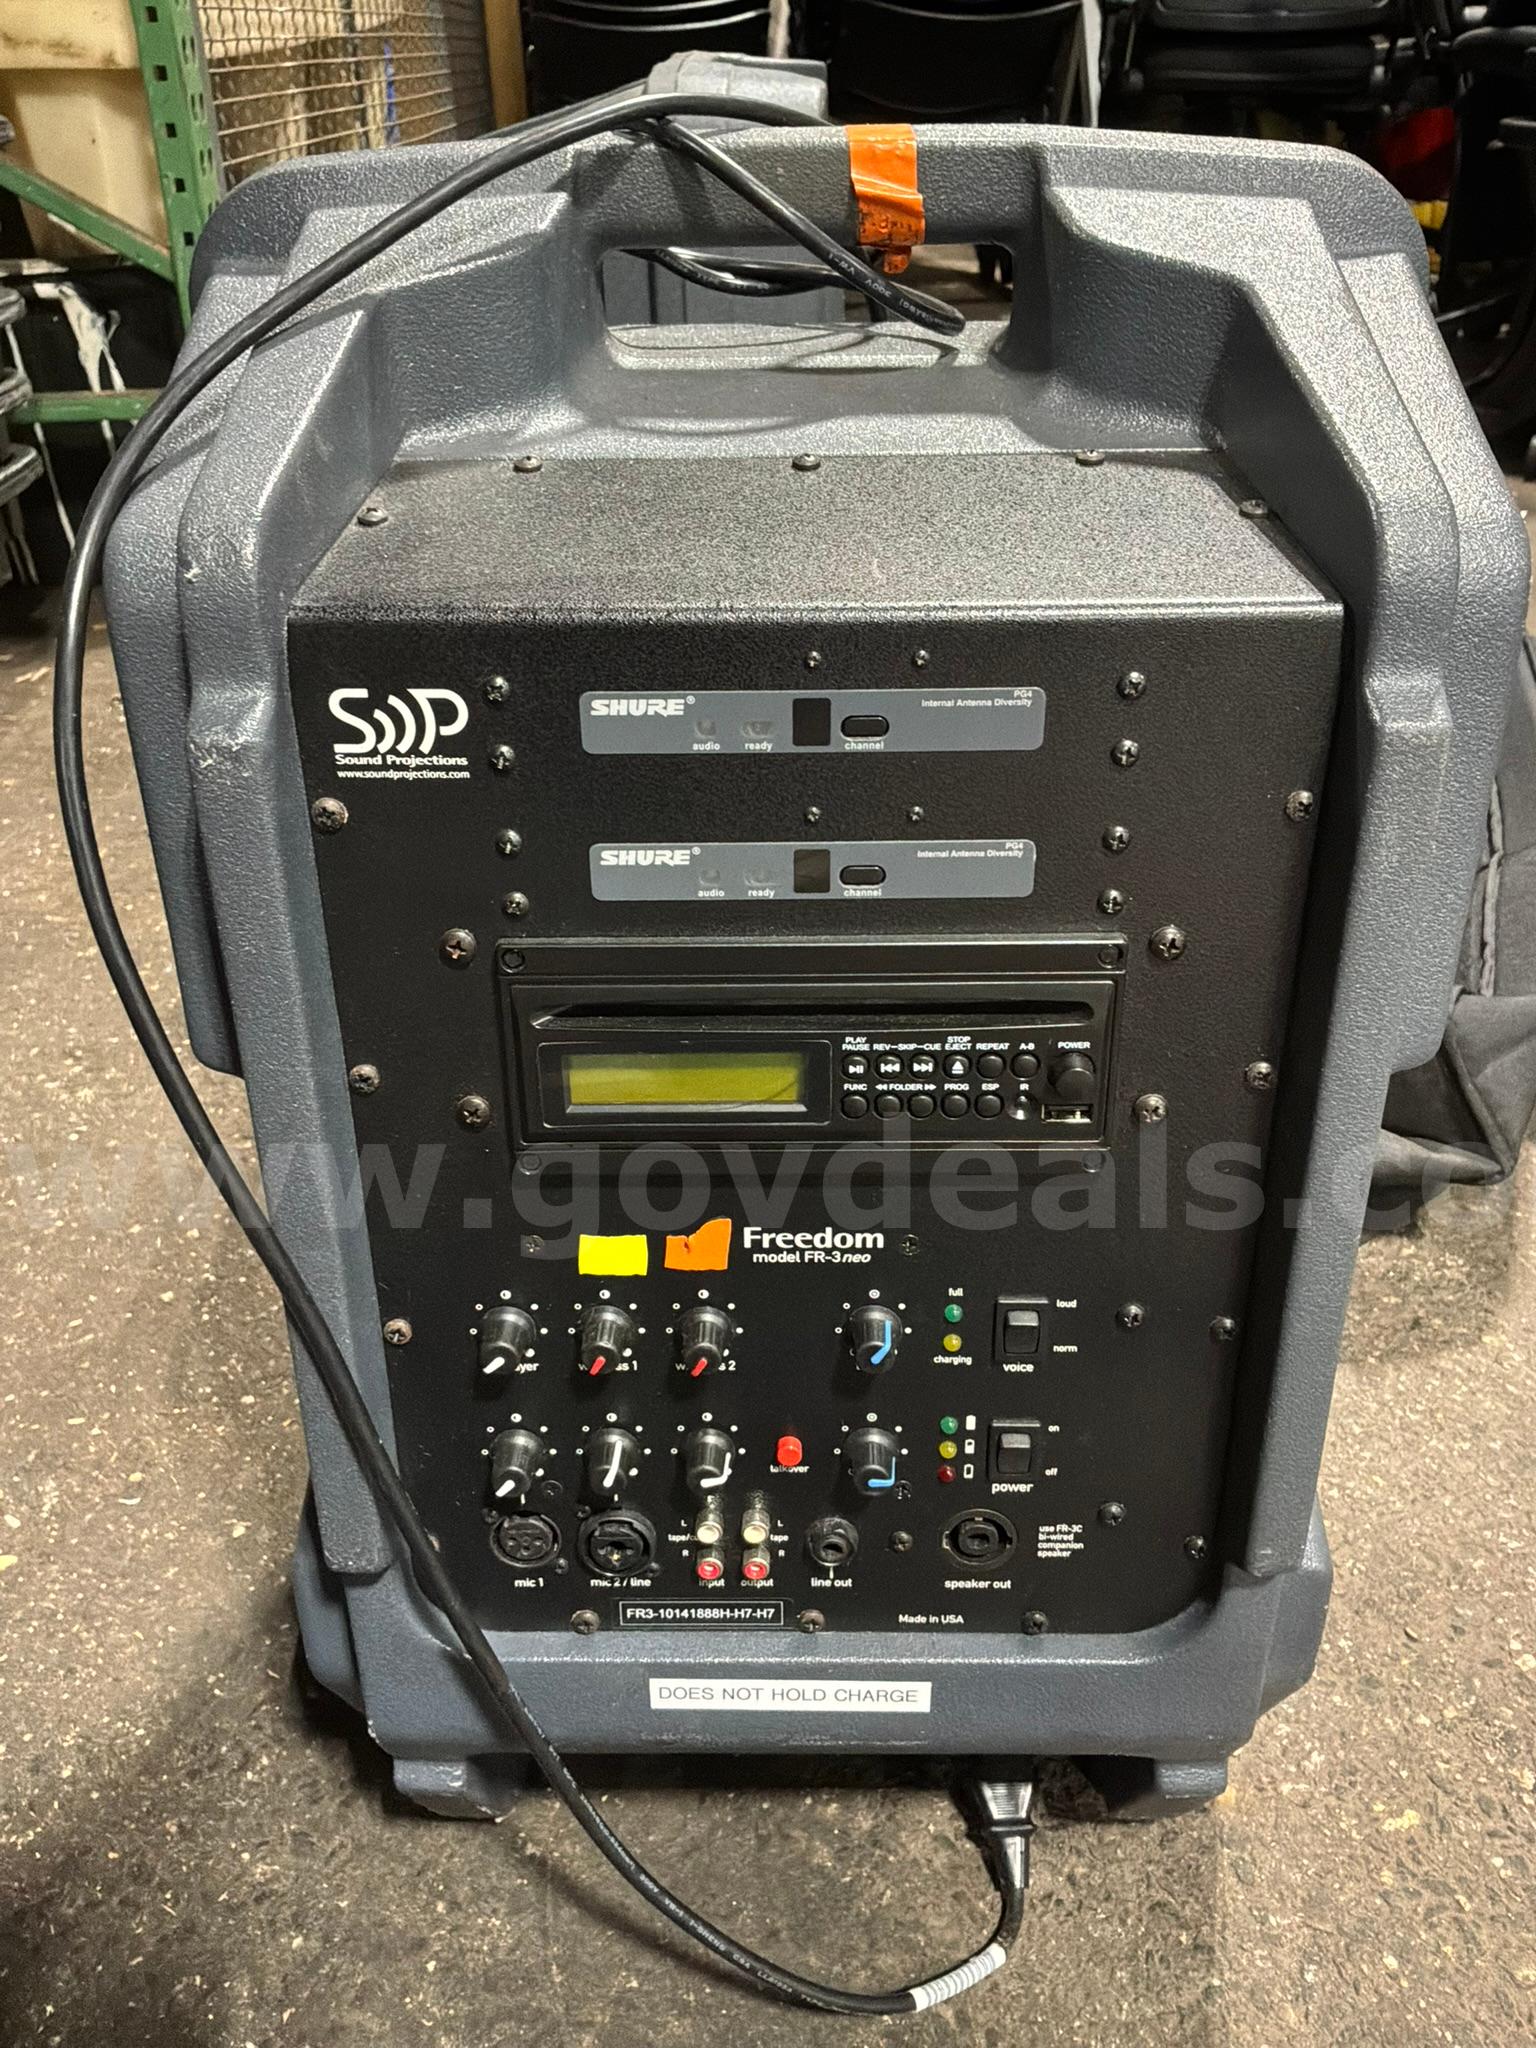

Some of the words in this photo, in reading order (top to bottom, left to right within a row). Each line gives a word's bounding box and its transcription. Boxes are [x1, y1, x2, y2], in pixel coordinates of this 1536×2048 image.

[1014, 690, 1032, 698] PG4
[921, 699, 955, 707] Internal
[957, 699, 992, 707] Antenna
[994, 699, 1032, 707] Diversity
[692, 742, 720, 751] audio
[744, 742, 773, 752] ready
[844, 741, 884, 750] channel
[335, 754, 382, 766] Sound
[387, 754, 468, 768] Projections
[337, 769, 470, 780] www.soundprojections.com
[1005, 842, 1023, 850] PG4
[917, 850, 948, 858] Internal
[951, 850, 985, 858] Antenna
[987, 850, 1023, 858] Diversity
[698, 889, 725, 897] audio
[748, 889, 775, 899] ready
[843, 888, 882, 897] channel
[743, 1227, 884, 1248] Freedom
[752, 1252, 801, 1263] model
[948, 1288, 963, 1296] full
[1056, 1299, 1076, 1308] loud
[1053, 1345, 1077, 1353] norm
[933, 1354, 972, 1365] charging
[728, 1360, 736, 1371] 2
[1003, 1362, 1034, 1372] voice
[1045, 1468, 1058, 1476] off
[991, 1483, 1033, 1495] power
[1056, 1524, 1083, 1532] FR-3C
[770, 1534, 789, 1543] tape
[1038, 1533, 1074, 1541] bi-wired
[1038, 1542, 1084, 1550] companion
[682, 1549, 689, 1557] R
[778, 1549, 785, 1557] R
[1037, 1550, 1072, 1558] speaker
[514, 1578, 536, 1587] mic
[590, 1578, 611, 1586] mic
[613, 1578, 621, 1587] 2
[630, 1578, 651, 1587] line
[699, 1578, 725, 1588] input
[740, 1578, 774, 1588] output
[811, 1578, 831, 1587] line
[834, 1578, 852, 1587] out
[944, 1579, 990, 1590] speaker
[992, 1579, 1011, 1589] out
[626, 1608, 775, 1620] FR3-10141888H-H7-H7
[899, 1615, 926, 1624] Made
[929, 1615, 939, 1623] in
[941, 1615, 964, 1623] USA
[659, 1686, 714, 1700] DOES
[722, 1687, 764, 1701] NOT
[772, 1688, 826, 1702] HOLD
[834, 1689, 918, 1703] CHARGE
